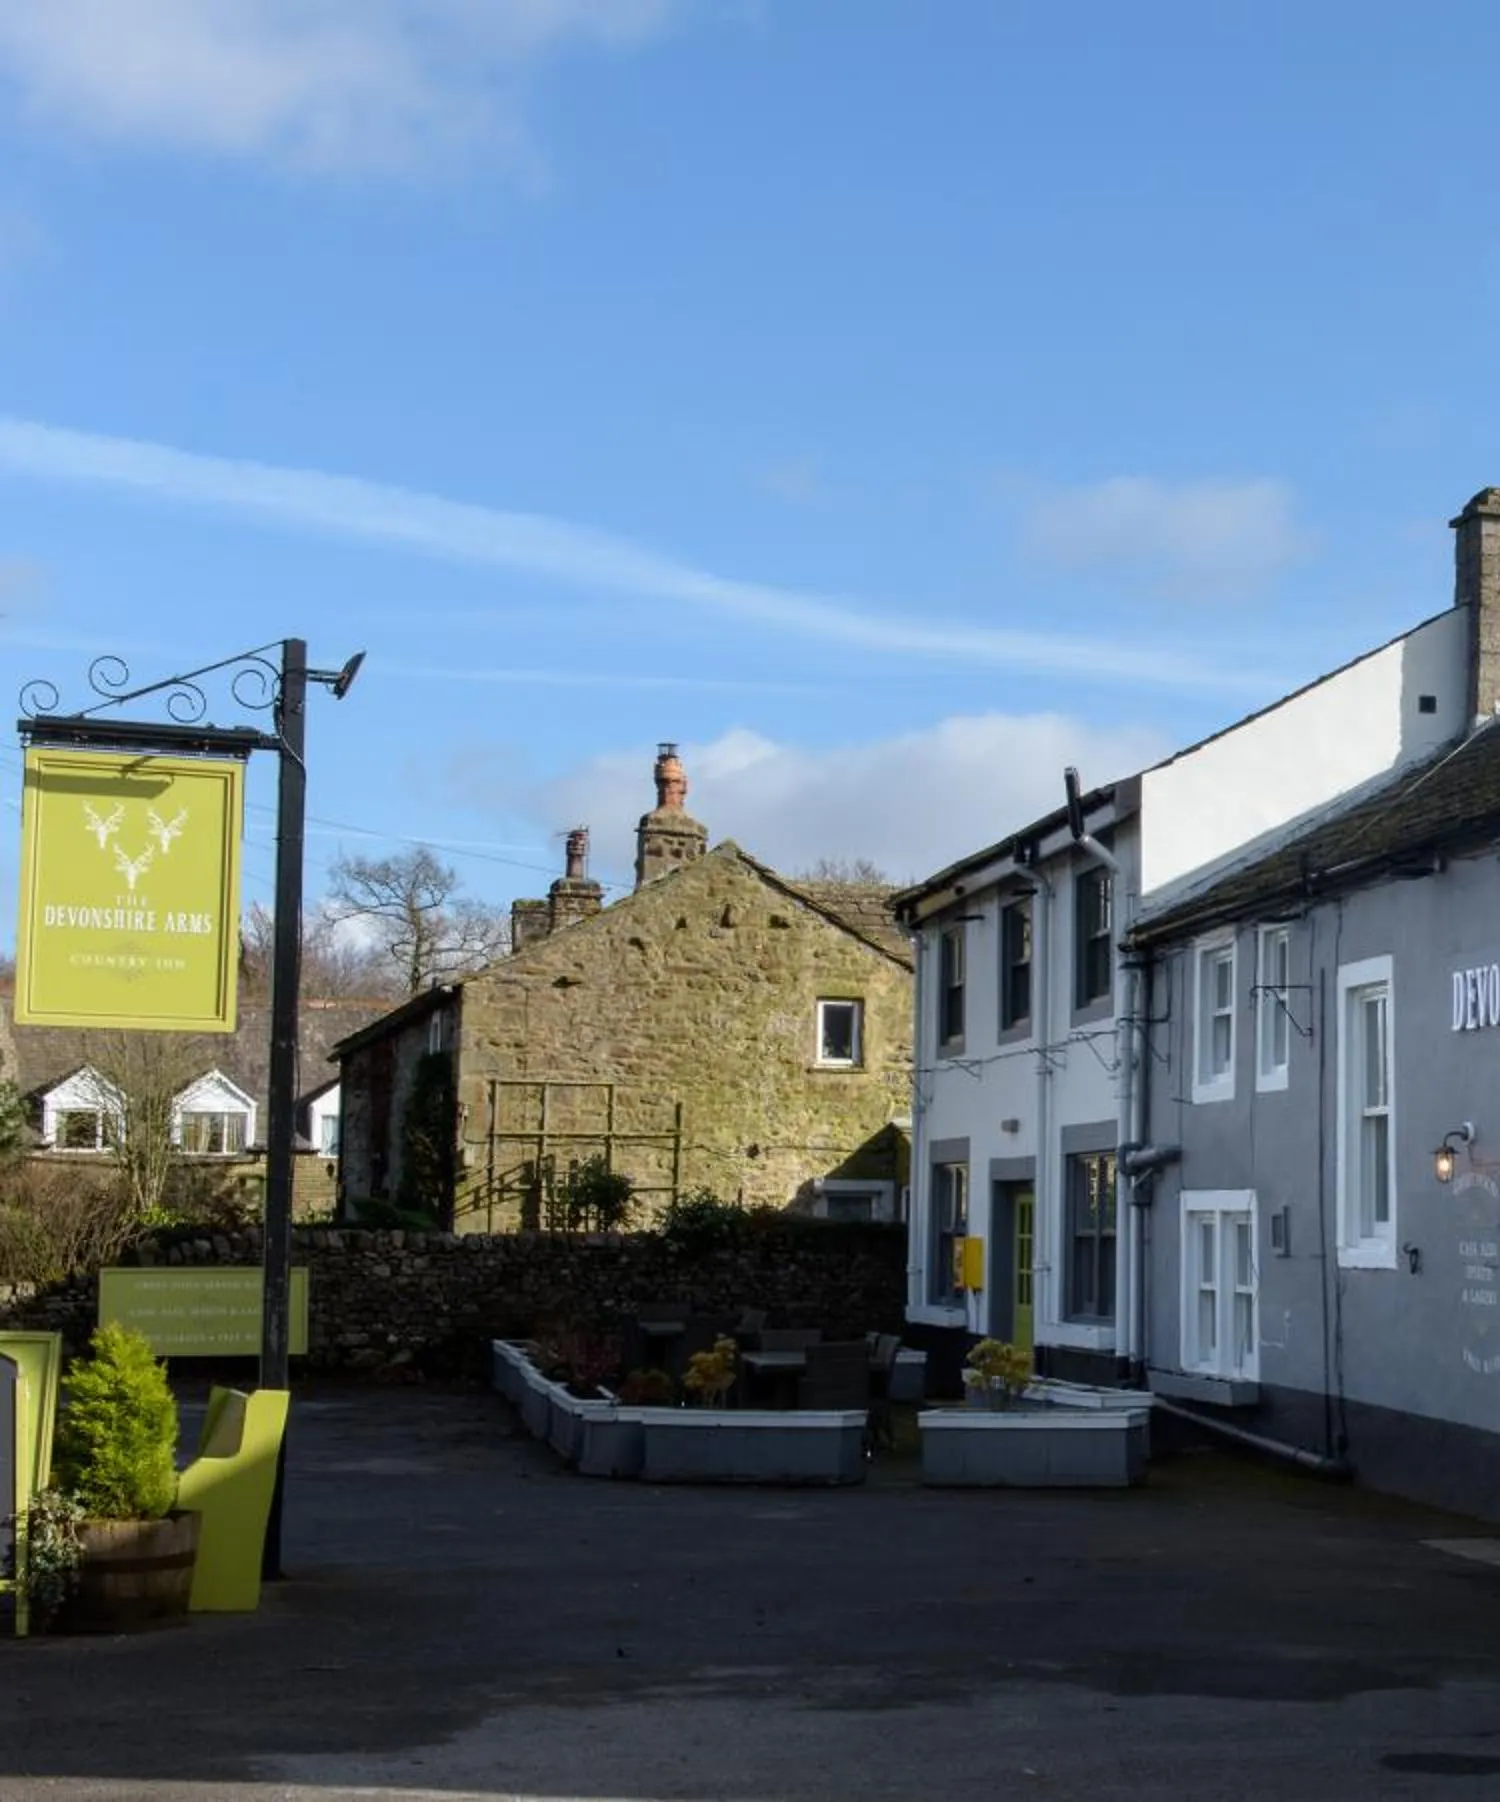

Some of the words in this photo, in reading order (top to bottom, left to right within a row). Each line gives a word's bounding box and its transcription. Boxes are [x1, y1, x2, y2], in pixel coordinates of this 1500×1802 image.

[44, 905, 157, 931] DEVONSHIRE
[164, 911, 213, 934] ARMS
[69, 953, 149, 969] COUNTRY
[156, 957, 186, 971] INN
